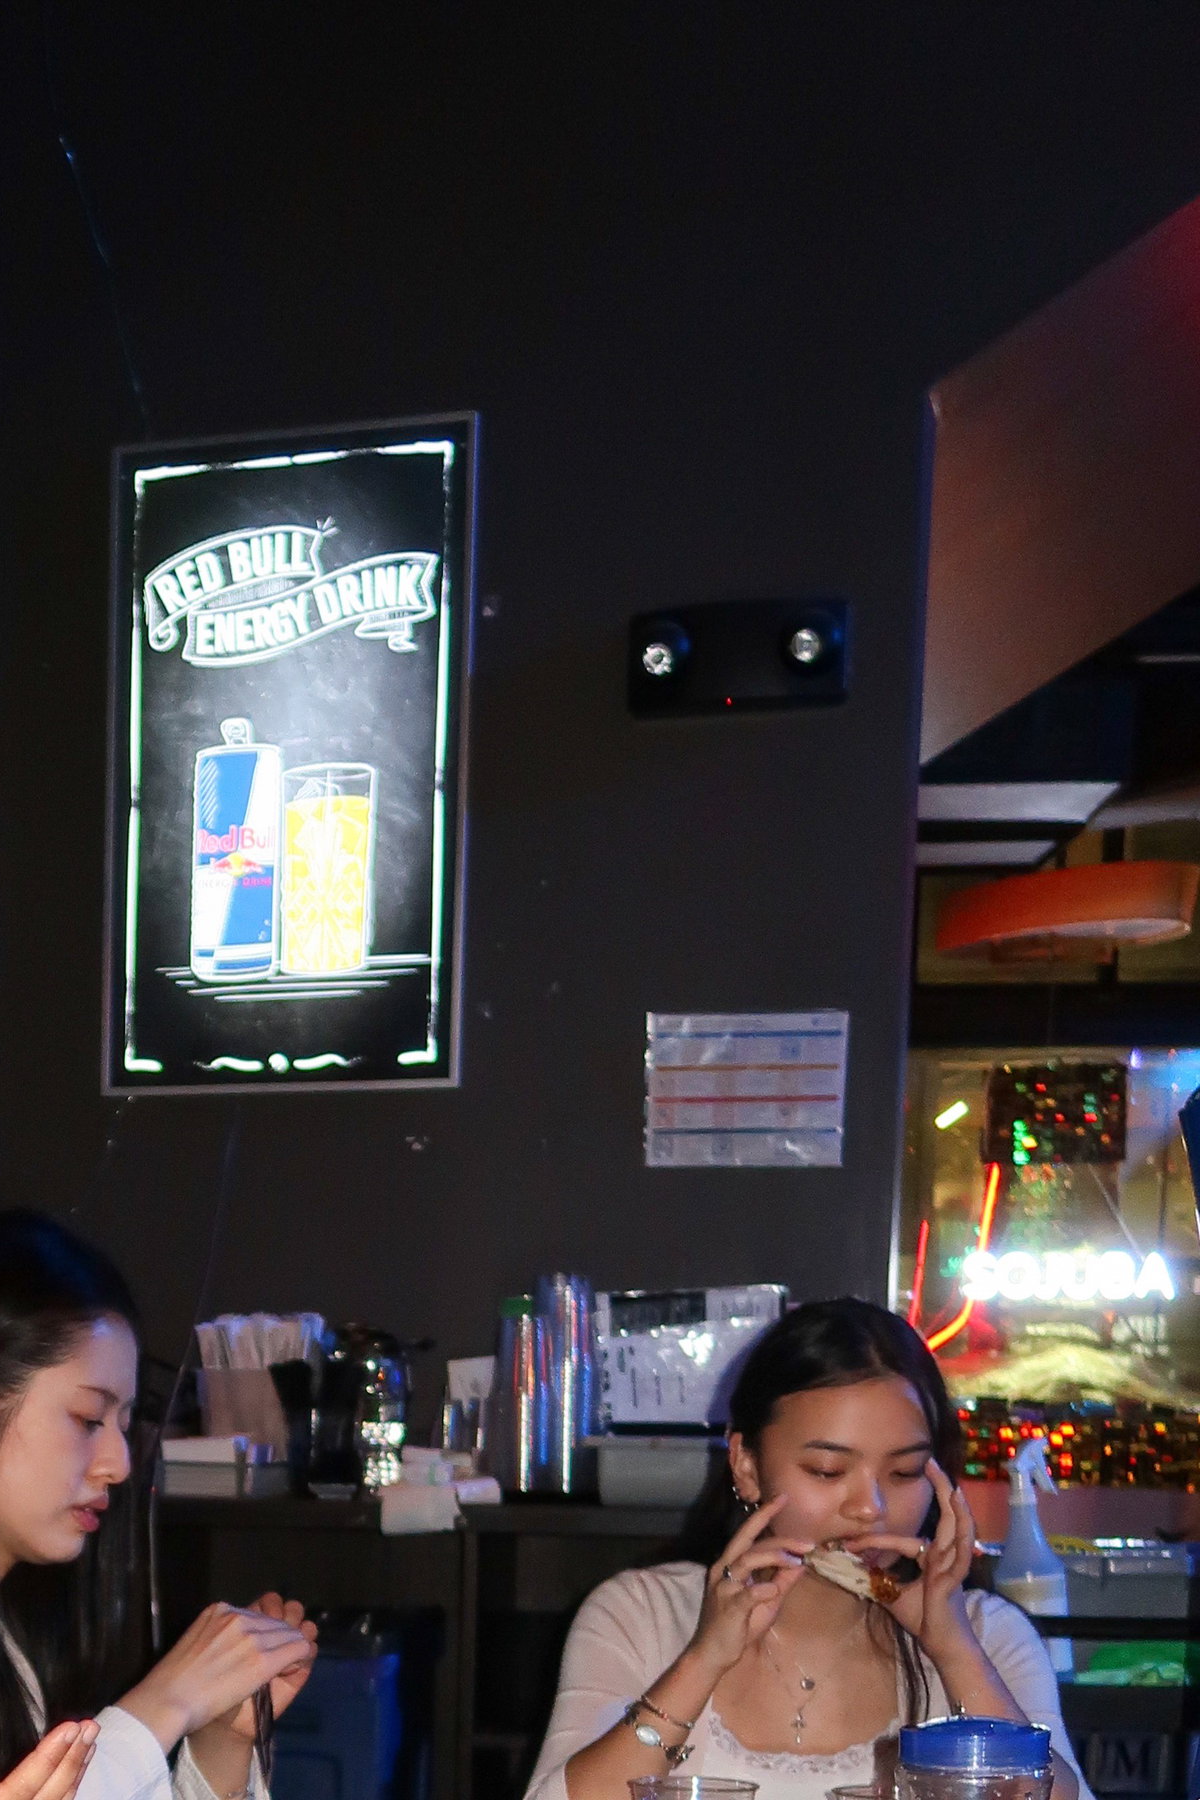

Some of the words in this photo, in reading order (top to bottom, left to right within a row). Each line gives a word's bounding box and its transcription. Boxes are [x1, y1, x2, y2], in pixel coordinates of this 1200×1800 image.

[153, 551, 227, 615] RED
[226, 531, 312, 583] BULL
[195, 589, 311, 656] ENERGY
[311, 564, 425, 625] DRINK
